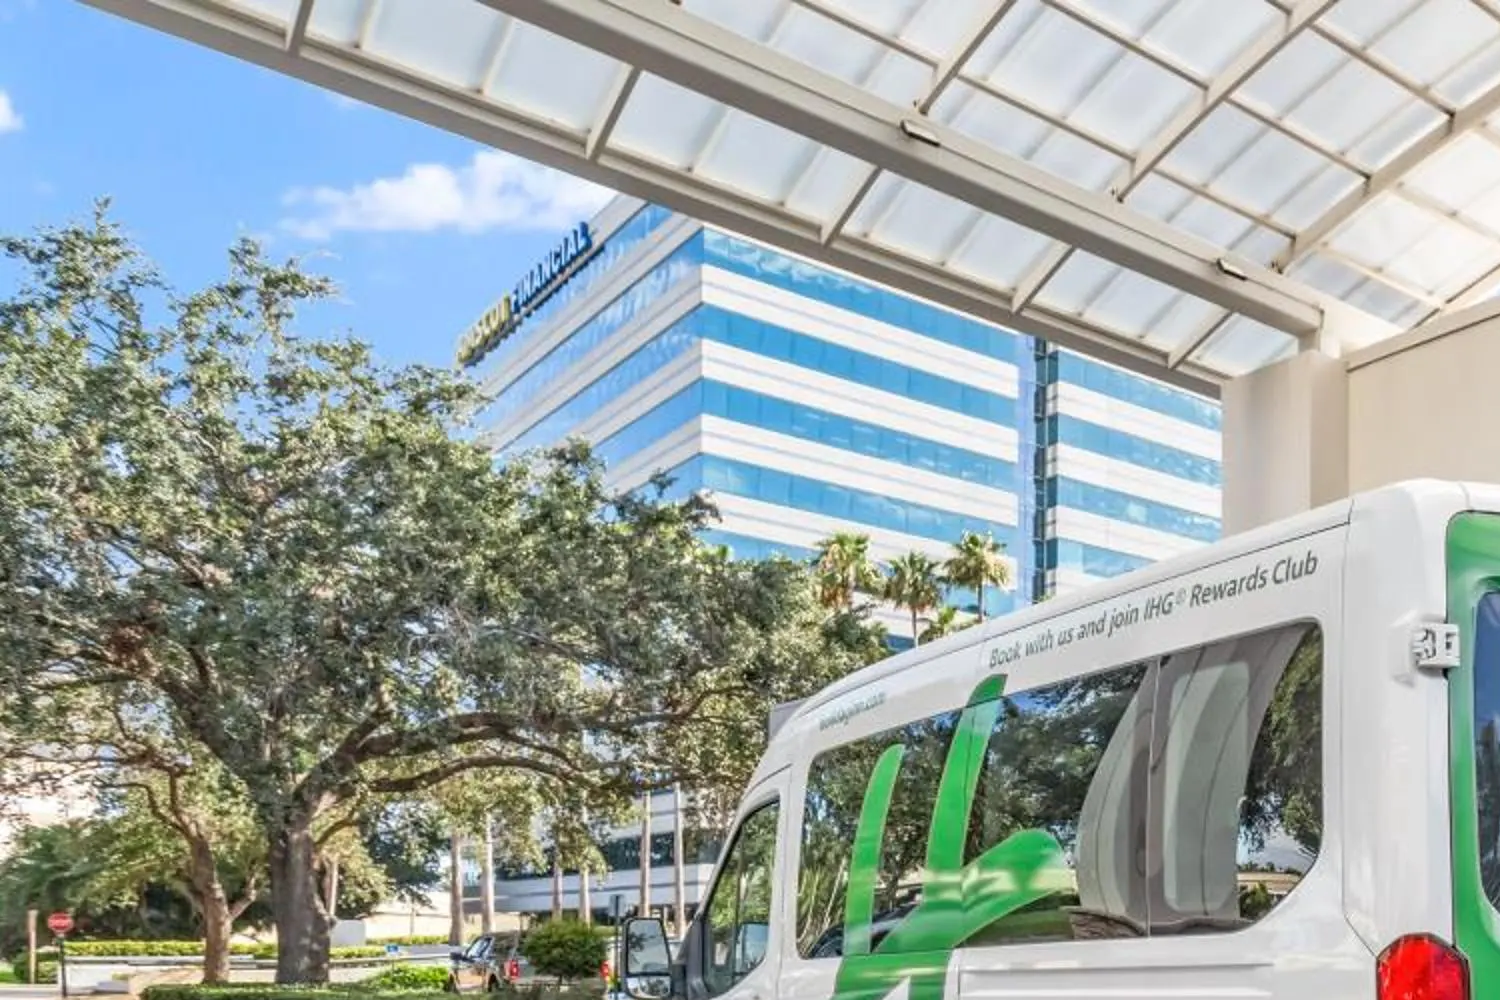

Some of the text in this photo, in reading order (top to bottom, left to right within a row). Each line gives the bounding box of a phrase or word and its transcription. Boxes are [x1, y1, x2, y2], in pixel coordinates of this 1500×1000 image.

[989, 641, 1021, 668] Book
[1025, 628, 1053, 657] with
[1057, 627, 1074, 647] us
[1077, 610, 1107, 640] and
[1108, 603, 1139, 638] join
[1190, 565, 1269, 608] Rewards
[1272, 550, 1319, 585] Club
